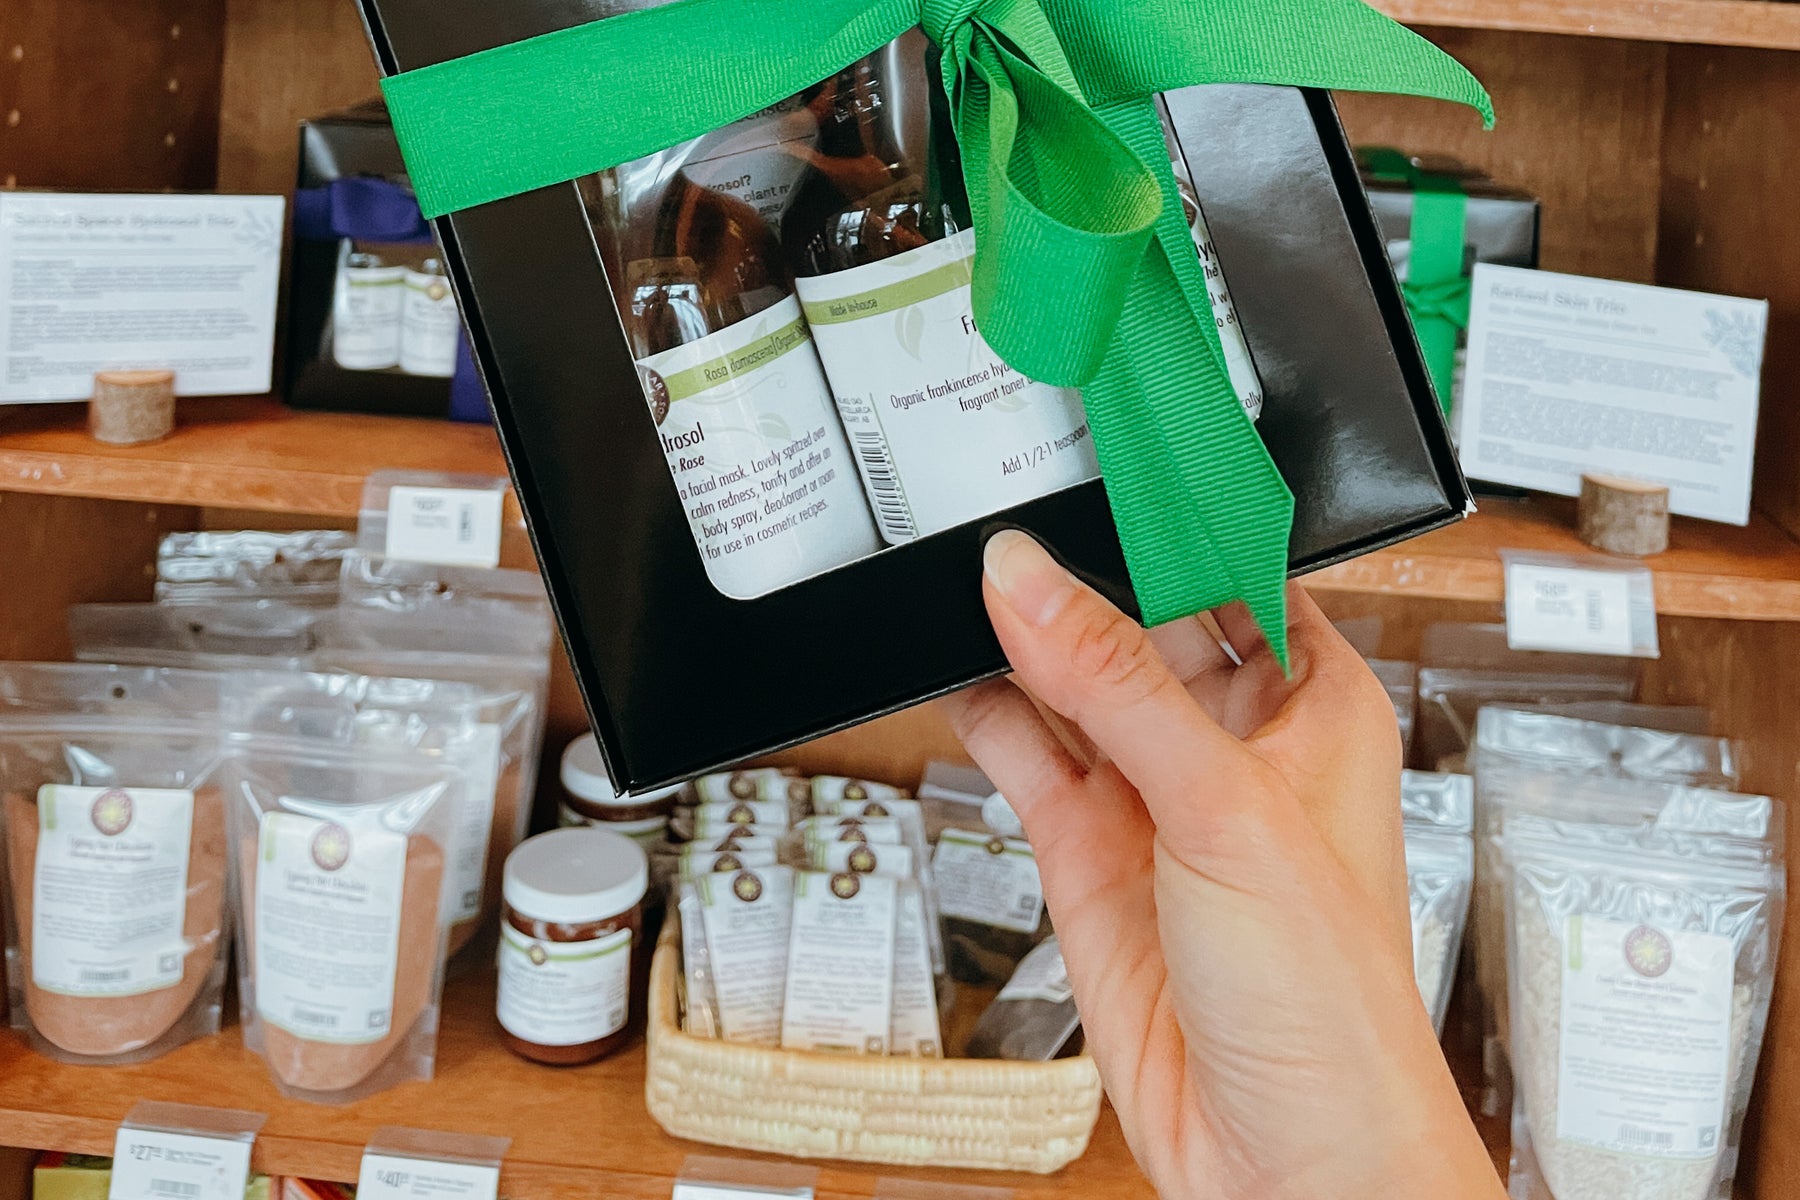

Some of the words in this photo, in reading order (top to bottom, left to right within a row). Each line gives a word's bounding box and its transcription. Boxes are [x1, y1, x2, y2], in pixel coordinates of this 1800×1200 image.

[707, 174, 751, 192] rosol?
[704, 365, 728, 383] Rosa
[890, 390, 926, 410] Organic
[926, 370, 990, 401] frankincense
[959, 387, 999, 413] fragrant
[1001, 377, 1025, 396] toner
[679, 455, 705, 473] Rose
[688, 475, 717, 499] facial
[751, 450, 782, 474] Lovely
[783, 431, 813, 460] spritzed
[1002, 456, 1022, 477] Add
[691, 502, 716, 520] calm
[717, 487, 760, 511] redness,
[761, 470, 787, 494] tonify
[789, 459, 806, 480] and
[702, 518, 728, 540] body
[731, 509, 763, 530] spray,
[764, 485, 808, 516] deodorant
[705, 545, 721, 561] for
[724, 540, 743, 555] use
[745, 533, 755, 547] in
[757, 513, 798, 542] cosmetic
